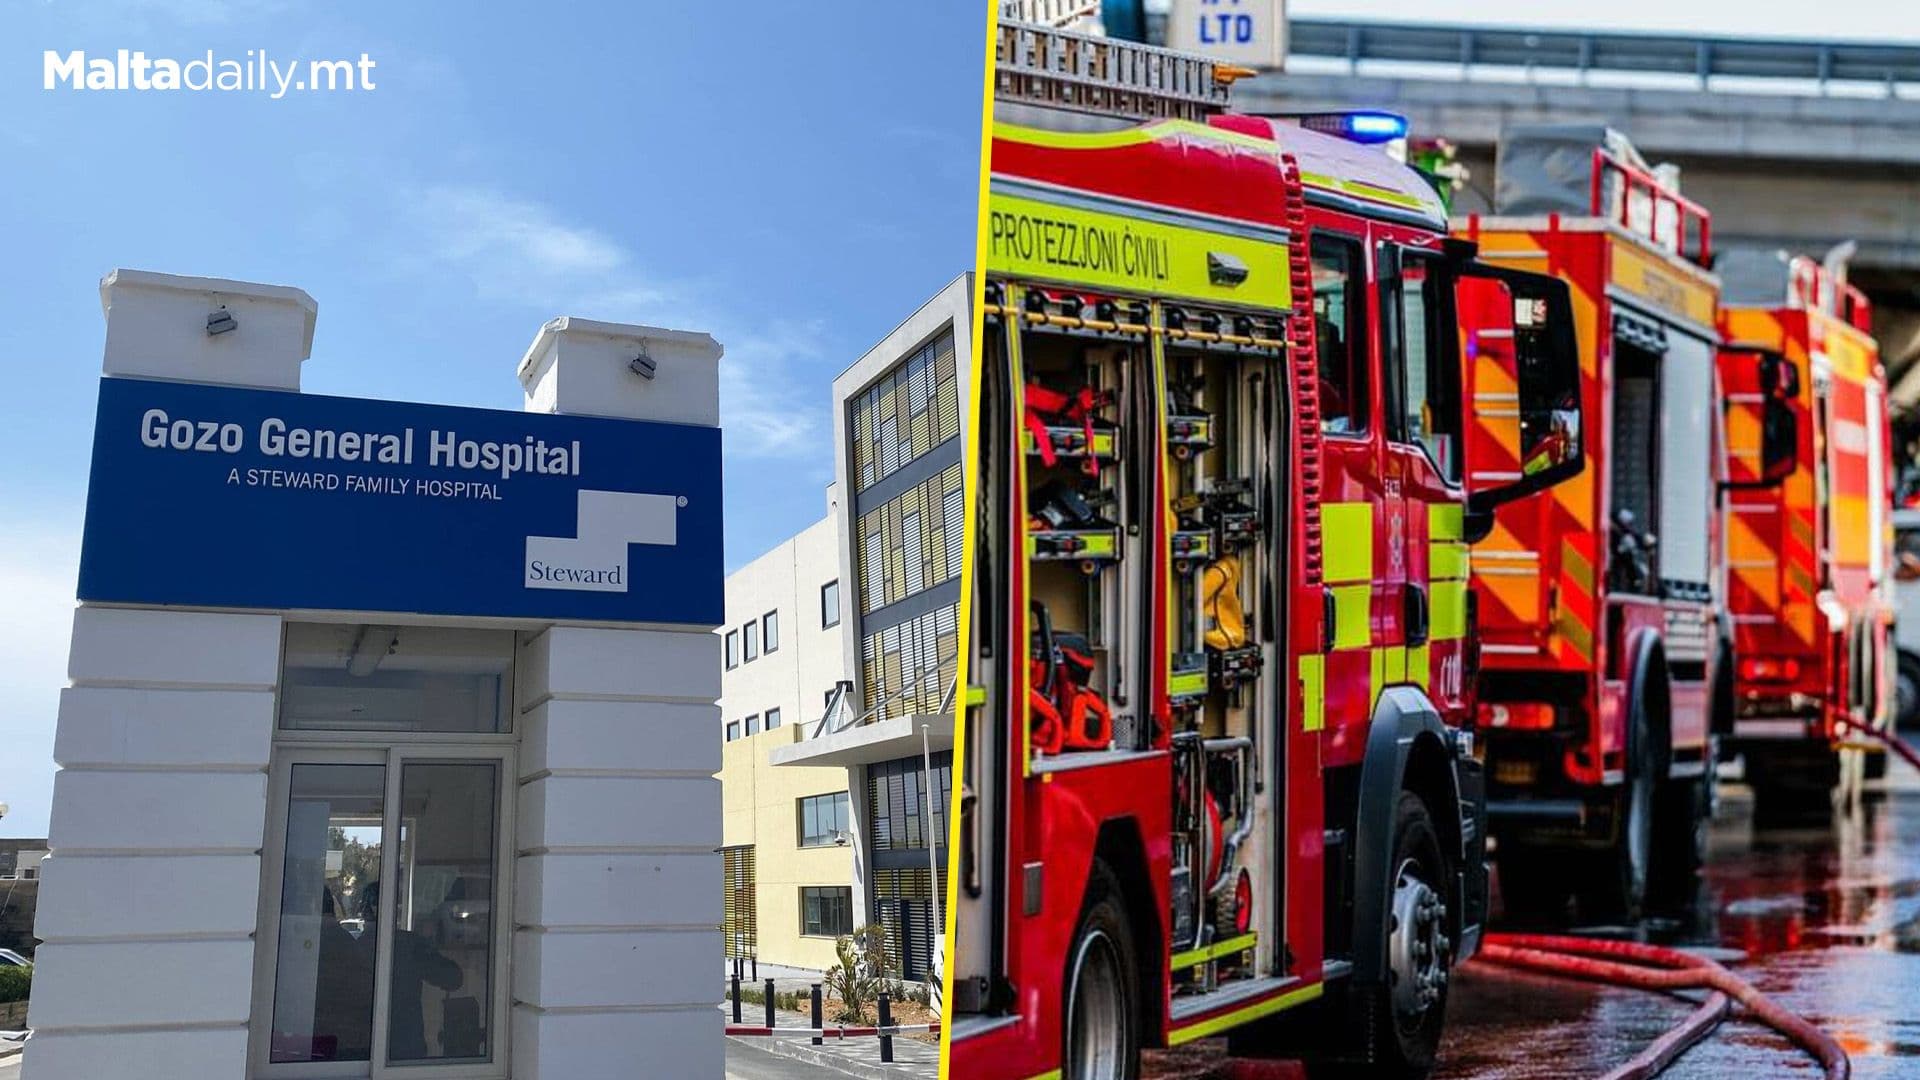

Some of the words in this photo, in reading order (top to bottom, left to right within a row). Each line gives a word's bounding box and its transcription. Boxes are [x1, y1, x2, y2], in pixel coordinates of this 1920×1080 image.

[1200, 14, 1251, 43] LTD
[991, 211, 1119, 274] PROTEZZJONI
[141, 408, 244, 453] Gozo
[259, 417, 413, 464] General
[429, 429, 580, 479] Hospital
[227, 468, 240, 484] A
[246, 469, 339, 490] STEWARD
[345, 475, 409, 495] FAMILY
[415, 480, 502, 500] HOSPITAL
[529, 561, 622, 585] Steward
